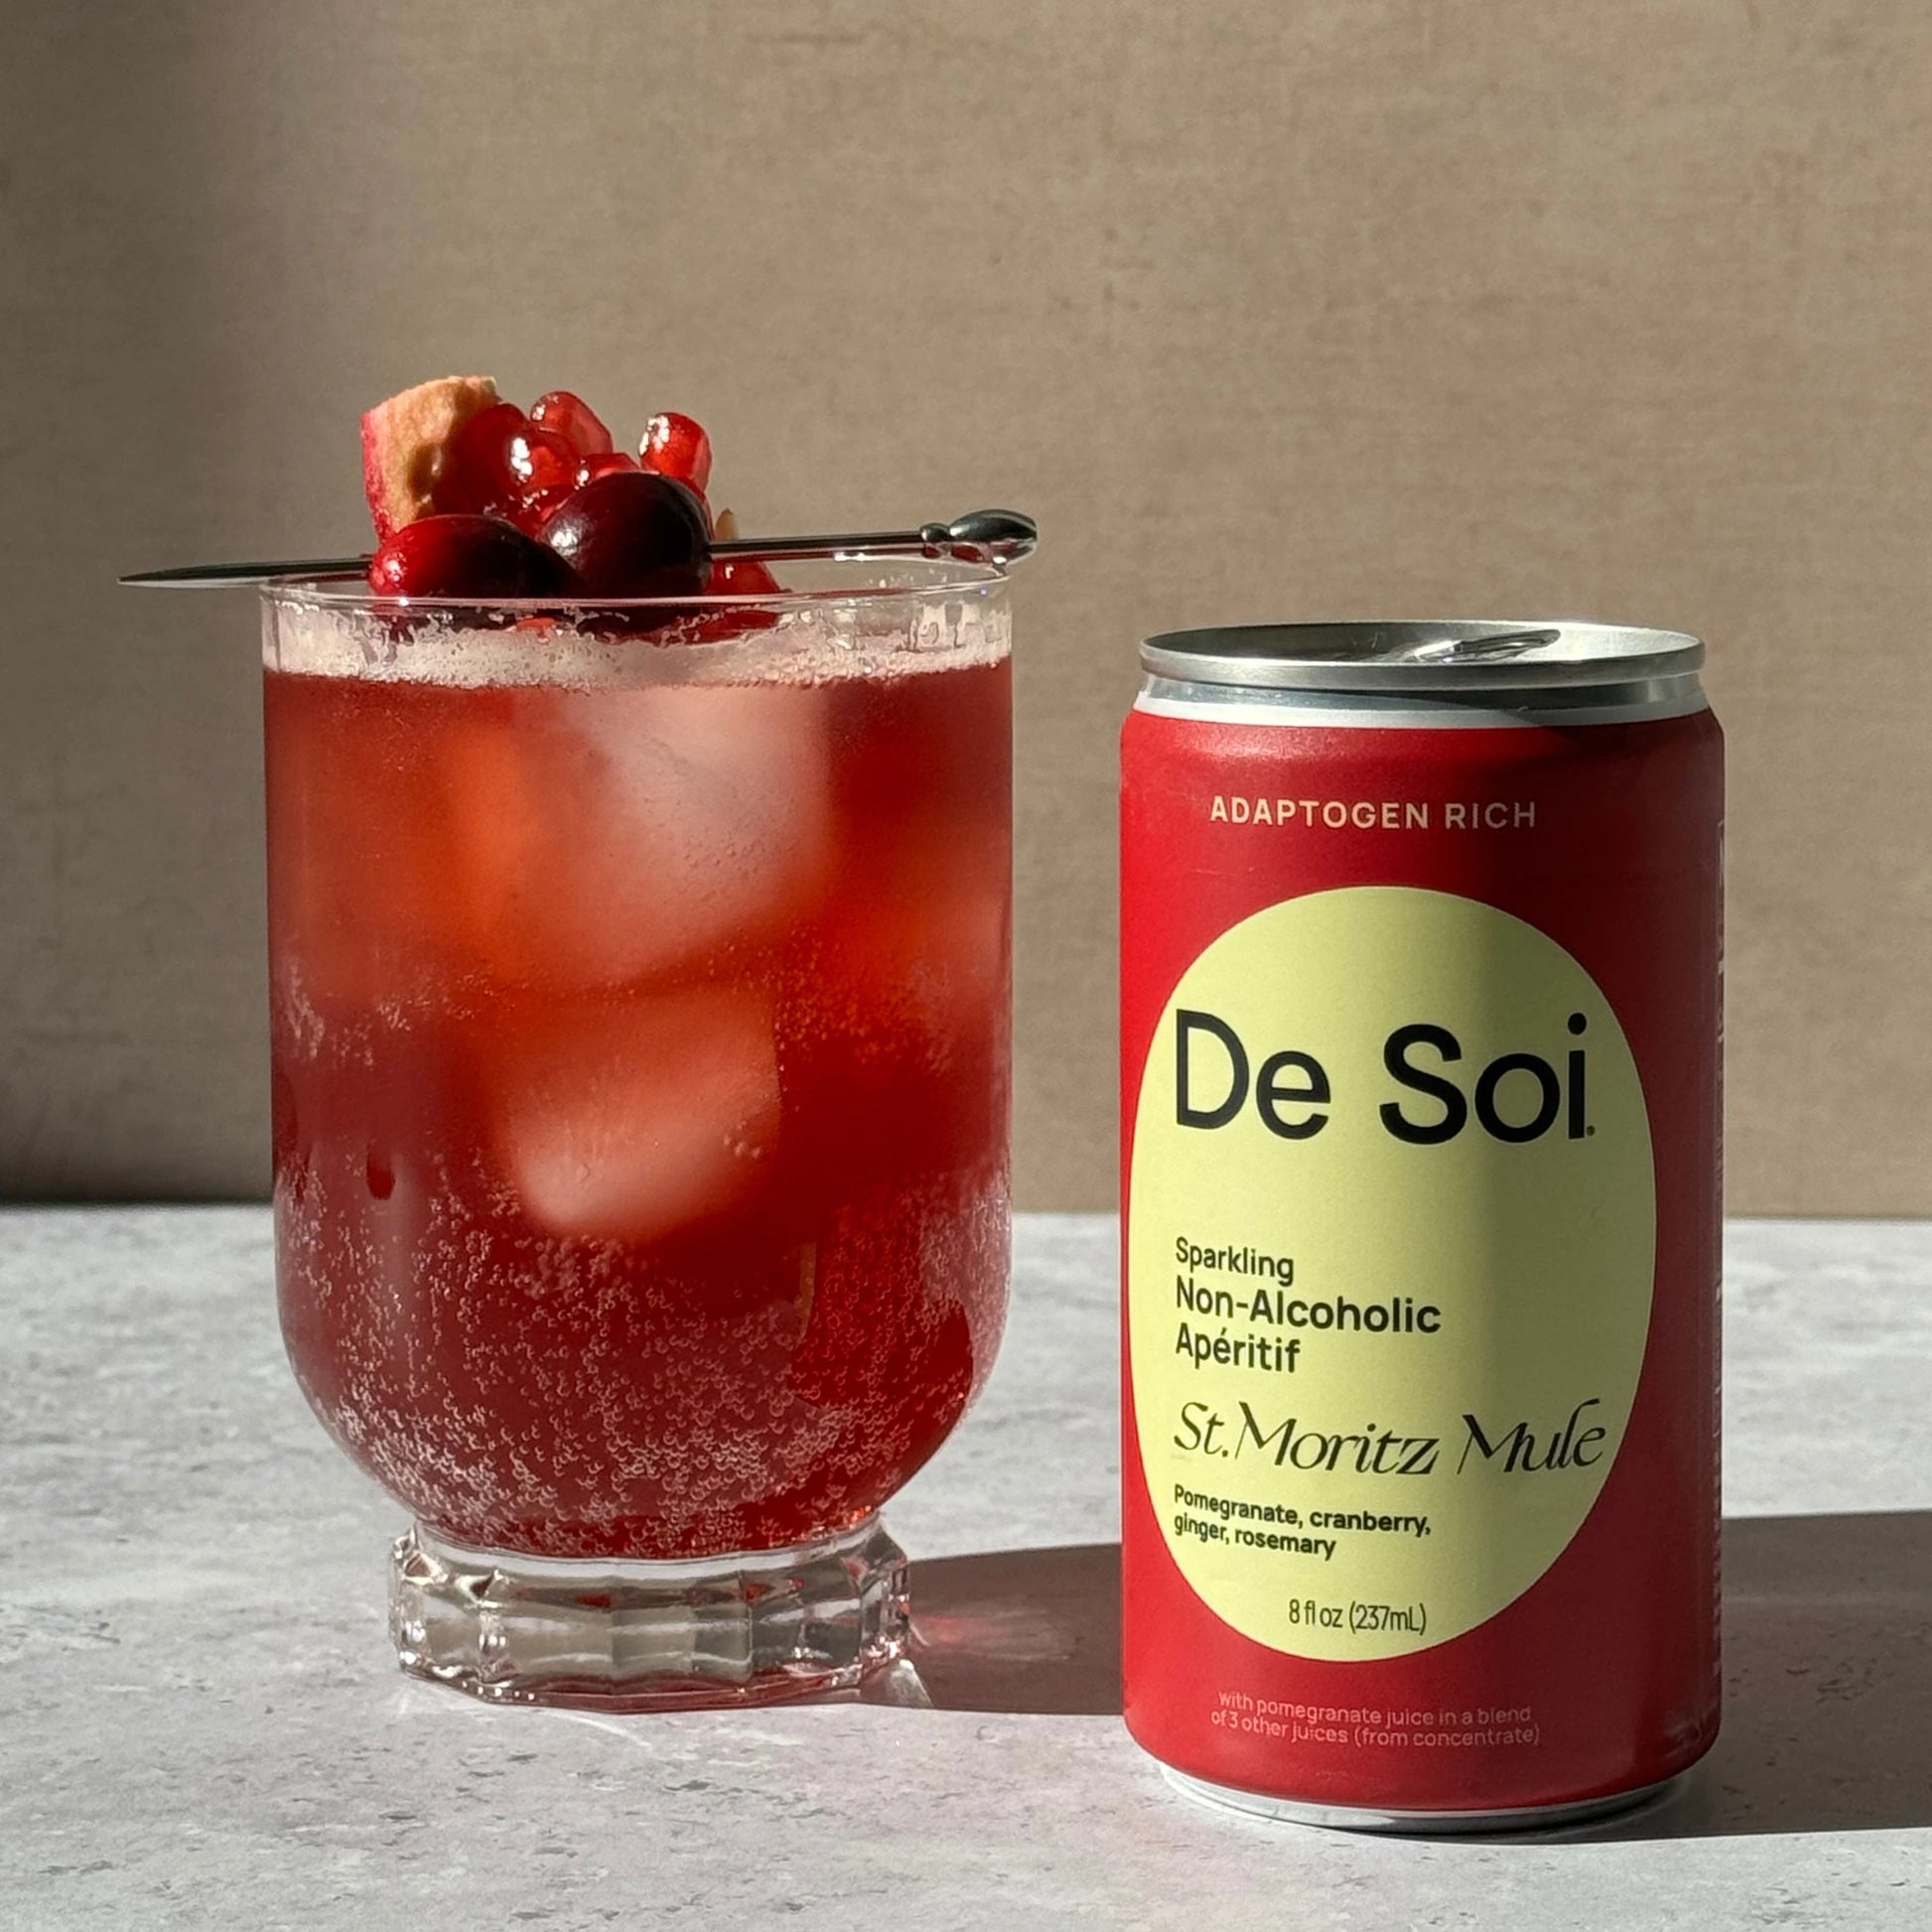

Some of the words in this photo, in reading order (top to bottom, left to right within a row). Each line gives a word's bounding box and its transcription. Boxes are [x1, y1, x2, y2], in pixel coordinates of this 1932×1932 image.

[1210, 796, 1429, 829] ADAPTOGEN
[1446, 802, 1536, 829] RICH
[1176, 1009, 1331, 1140] De
[1175, 1236, 1295, 1287] Sparkling
[1176, 1275, 1442, 1333] Non-Alcoholic
[1175, 1322, 1301, 1373] Apéritif
[1234, 1401, 1440, 1474] Moritz
[1456, 1398, 1606, 1474] Mule
[1174, 1484, 1303, 1529] Pomegranate,
[1310, 1510, 1431, 1537] cranberry,
[1174, 1513, 1229, 1545] ginger,
[1235, 1528, 1336, 1561] rosemary
[1289, 1598, 1300, 1624] 8
[1305, 1600, 1315, 1625] fl
[1319, 1606, 1343, 1628] oz
[1349, 1600, 1427, 1636] (237mL)
[1210, 1710, 1228, 1725] of
[1229, 1712, 1239, 1727] 3
[1242, 1716, 1288, 1737] other
[1292, 1724, 1348, 1743] juices
[1355, 1726, 1408, 1748] (from
[1413, 1725, 1541, 1746] concentrate)
[1218, 1691, 1253, 1712] with
[1257, 1699, 1382, 1725] pomegranate
[1386, 1708, 1434, 1727] juice
[1440, 1708, 1456, 1725] in
[1461, 1710, 1473, 1725] a
[1478, 1706, 1532, 1724] blend
